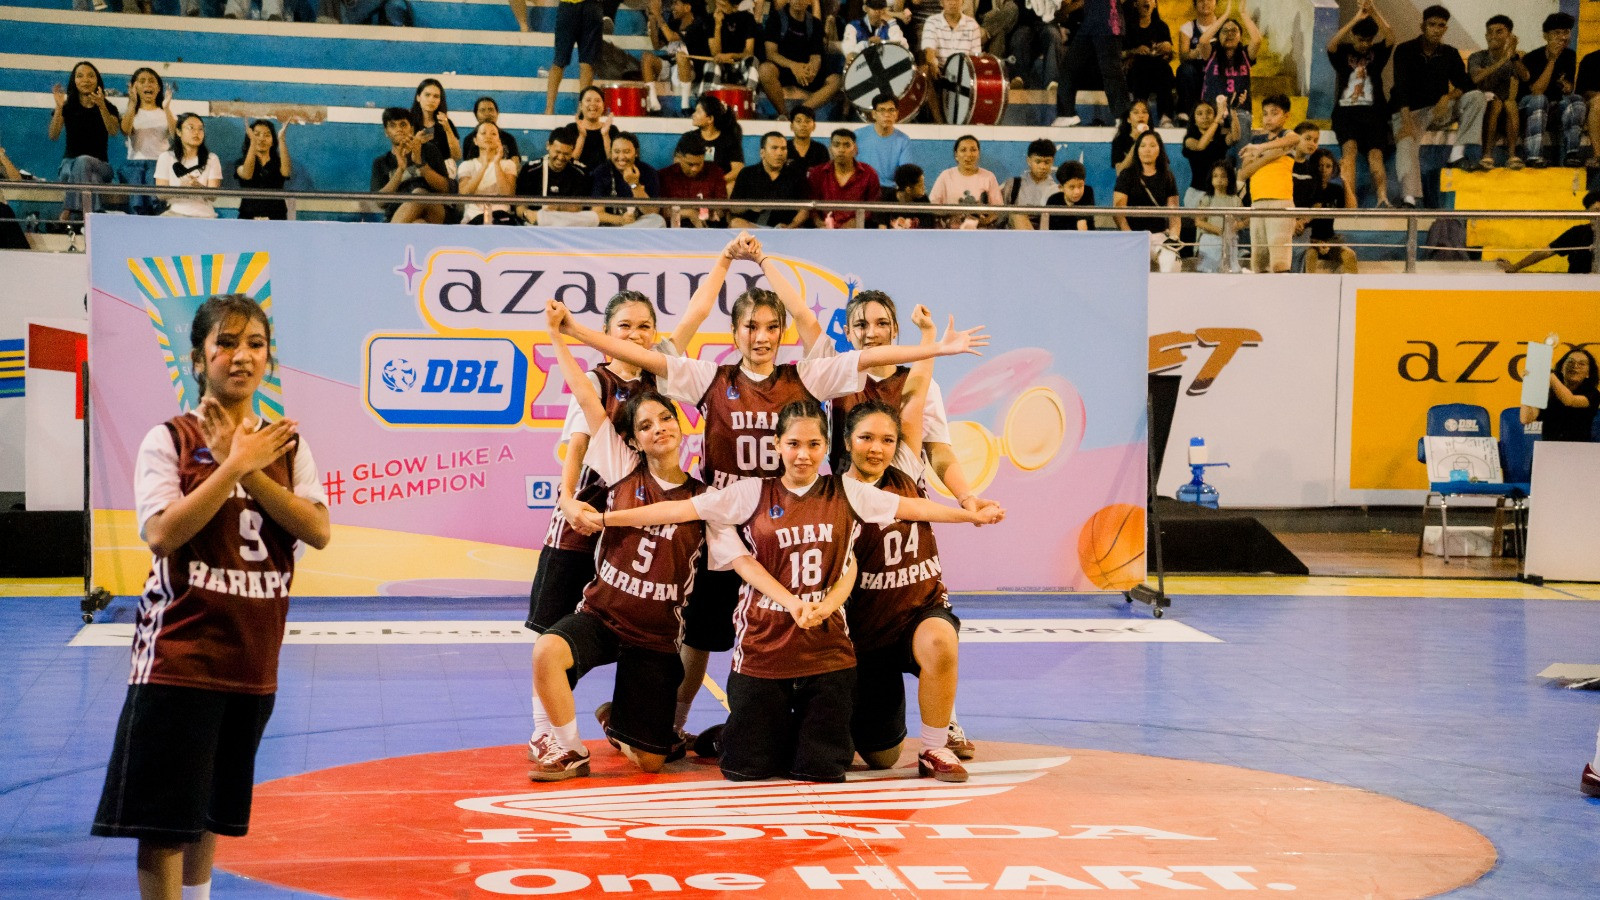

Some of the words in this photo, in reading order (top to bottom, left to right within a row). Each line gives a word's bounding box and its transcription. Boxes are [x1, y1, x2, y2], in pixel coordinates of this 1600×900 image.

[1226, 79, 1236, 93] 3
[420, 358, 504, 394] DBL
[1457, 418, 1479, 428] DBL
[352, 455, 429, 482] GLOW
[436, 447, 490, 471] LIKE
[498, 444, 515, 463] A
[735, 434, 781, 472] 06
[352, 471, 487, 506] CHAMPION
[238, 508, 269, 562] 9
[775, 523, 834, 550] DIAN
[883, 522, 920, 567] 04
[631, 536, 657, 574] 5
[789, 548, 823, 590] 18
[860, 555, 943, 591] HARAPAN
[599, 558, 679, 602] HARAPAN
[464, 824, 1218, 844] HONDA
[475, 867, 767, 895] One
[793, 865, 1298, 891] HEART.
